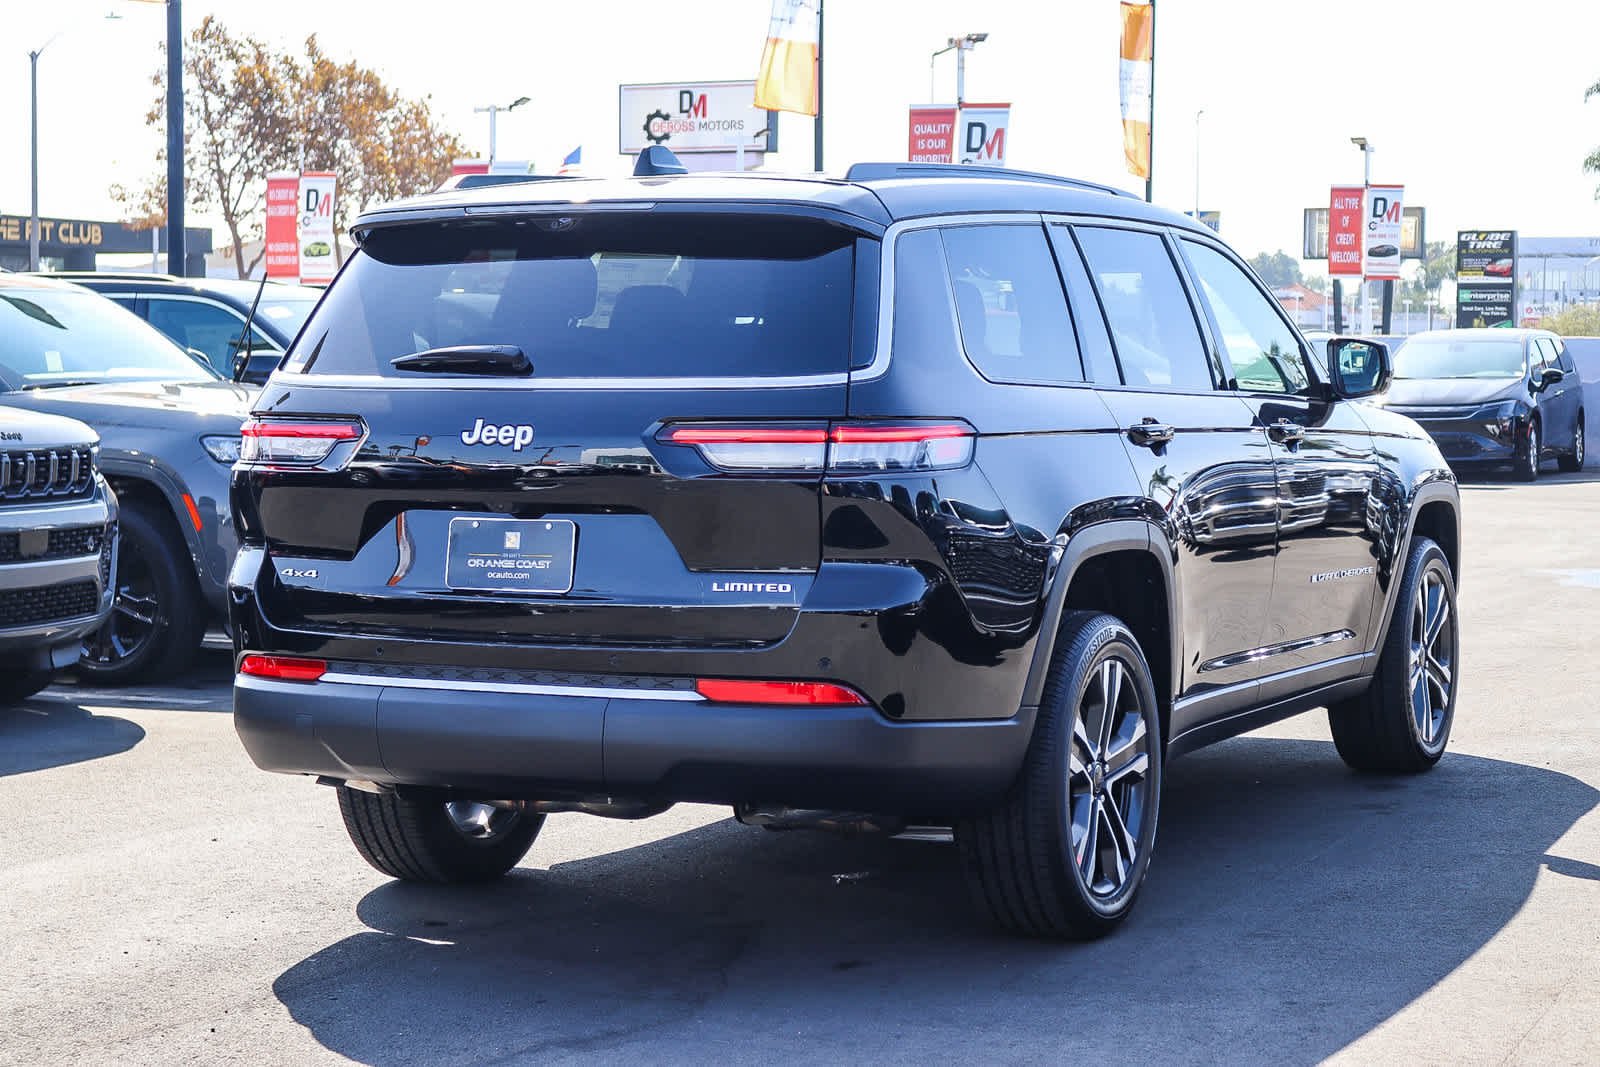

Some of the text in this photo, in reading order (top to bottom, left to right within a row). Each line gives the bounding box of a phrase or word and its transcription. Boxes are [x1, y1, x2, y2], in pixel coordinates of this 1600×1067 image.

[699, 119, 744, 131] MOTORS
[914, 123, 952, 135] QUALITY
[918, 138, 946, 150] IS OUR
[58, 221, 103, 245] CLUB
[1335, 233, 1355, 245] CREDIT
[1469, 240, 1503, 249] TIRE
[1331, 251, 1360, 263] WELCOME
[1463, 292, 1510, 301] enterprise
[461, 418, 533, 451] Jeep
[467, 558, 552, 569] ORANGE COAST
[280, 568, 318, 578] 4x4
[487, 571, 530, 579] ocauto.com
[712, 582, 792, 592] LIMITED
